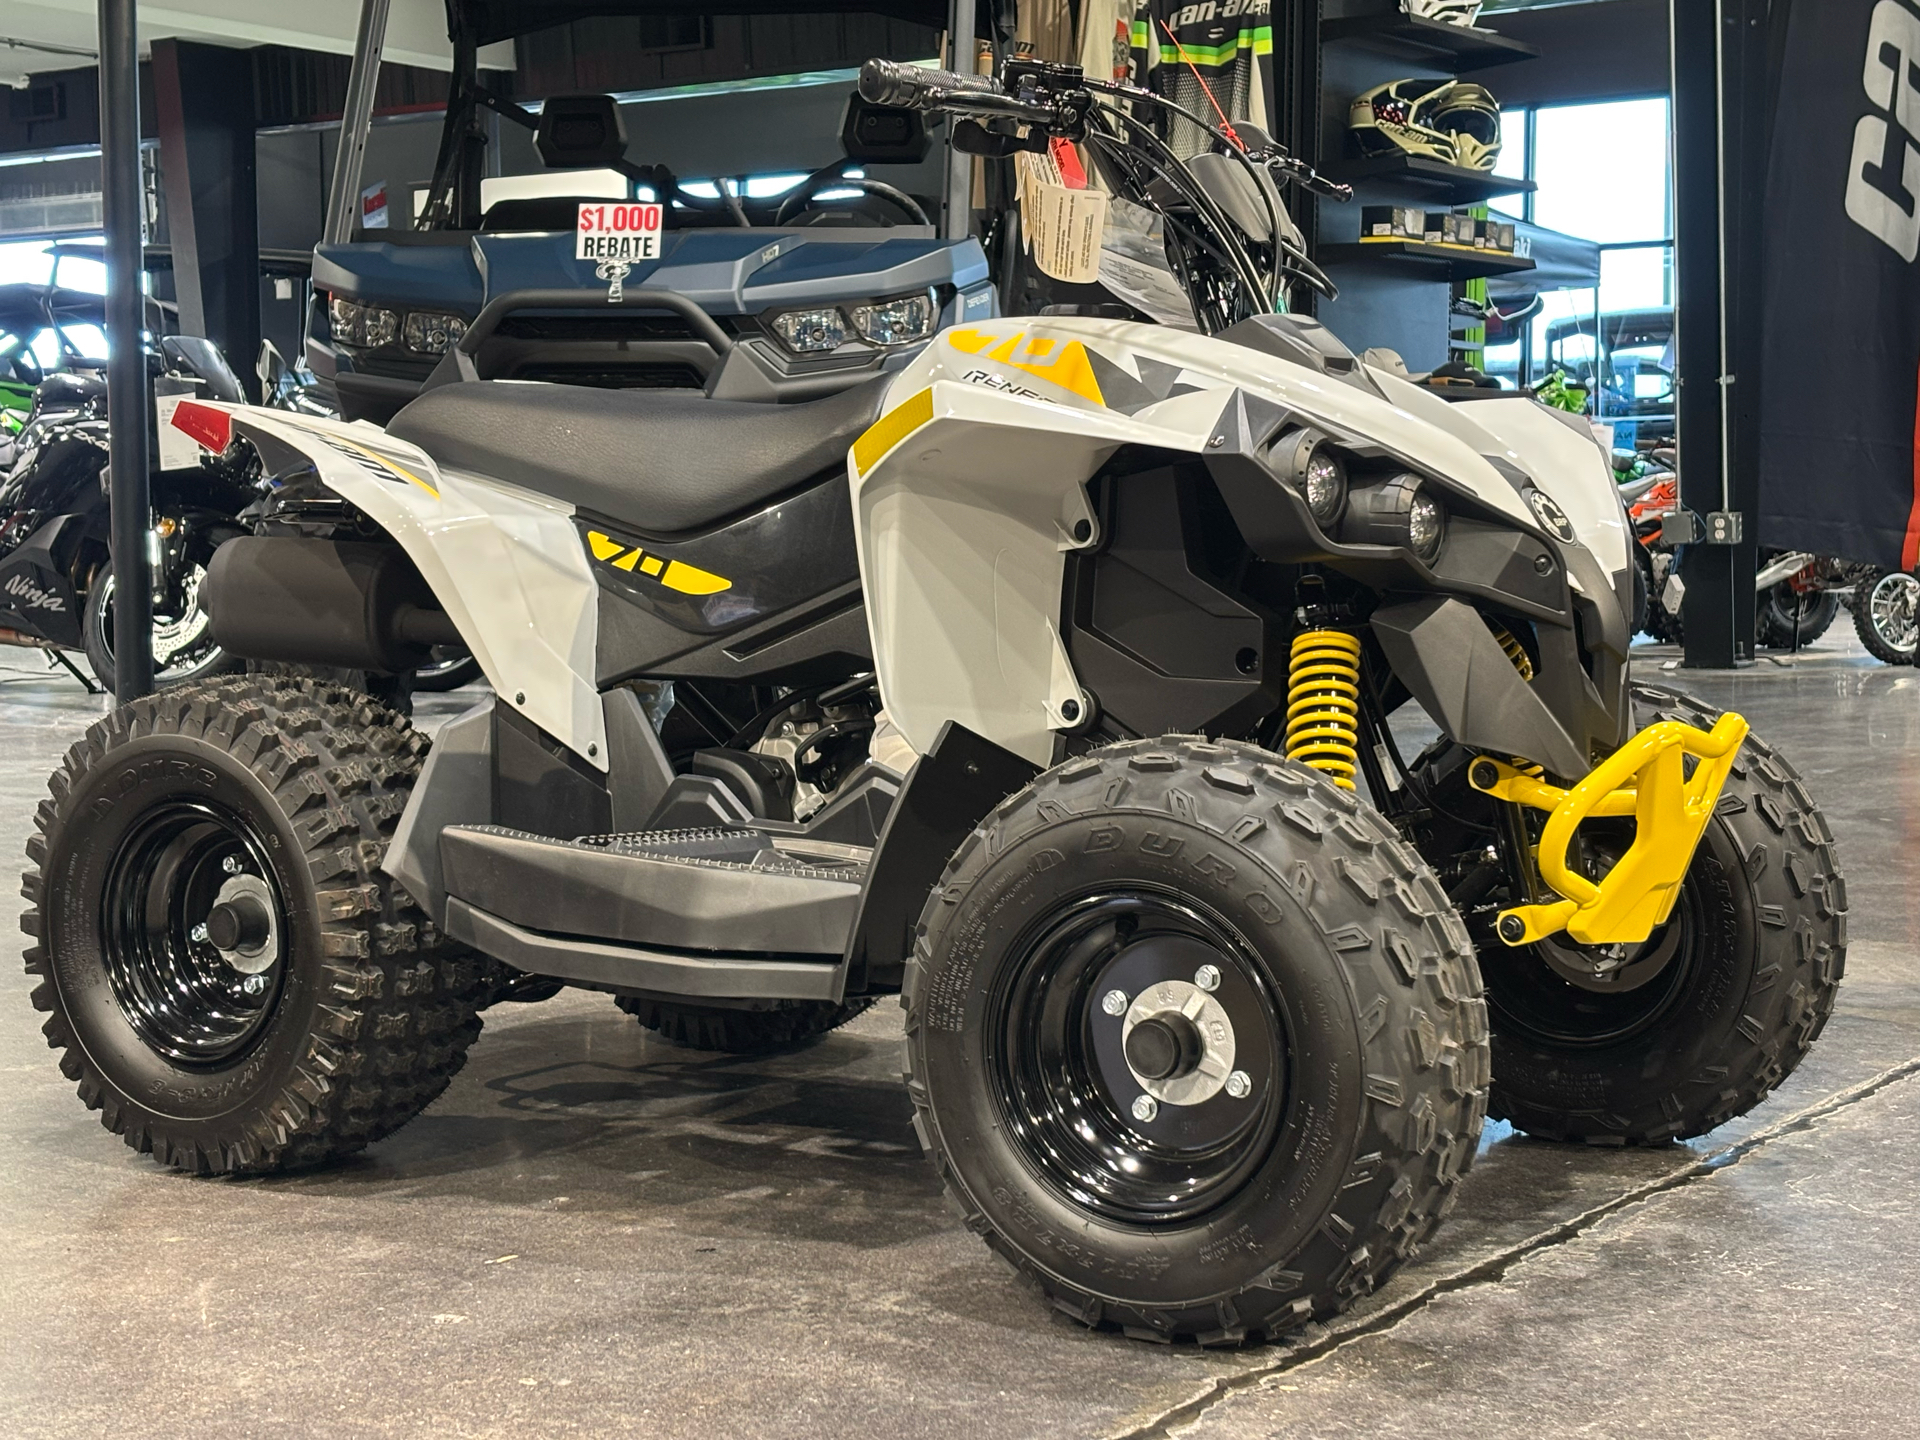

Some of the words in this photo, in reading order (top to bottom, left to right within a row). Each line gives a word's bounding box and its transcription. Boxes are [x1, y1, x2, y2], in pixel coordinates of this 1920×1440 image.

[1375, 119, 1428, 144] can-am
[1845, 0, 1920, 263] ca
[580, 206, 659, 234] $1,000
[583, 236, 653, 257] REBATE
[761, 245, 780, 263] HD7
[962, 369, 1057, 404] RENE
[1553, 517, 1568, 527] BRP
[4, 573, 66, 613] Ninja
[1083, 825, 1283, 926] DURO
